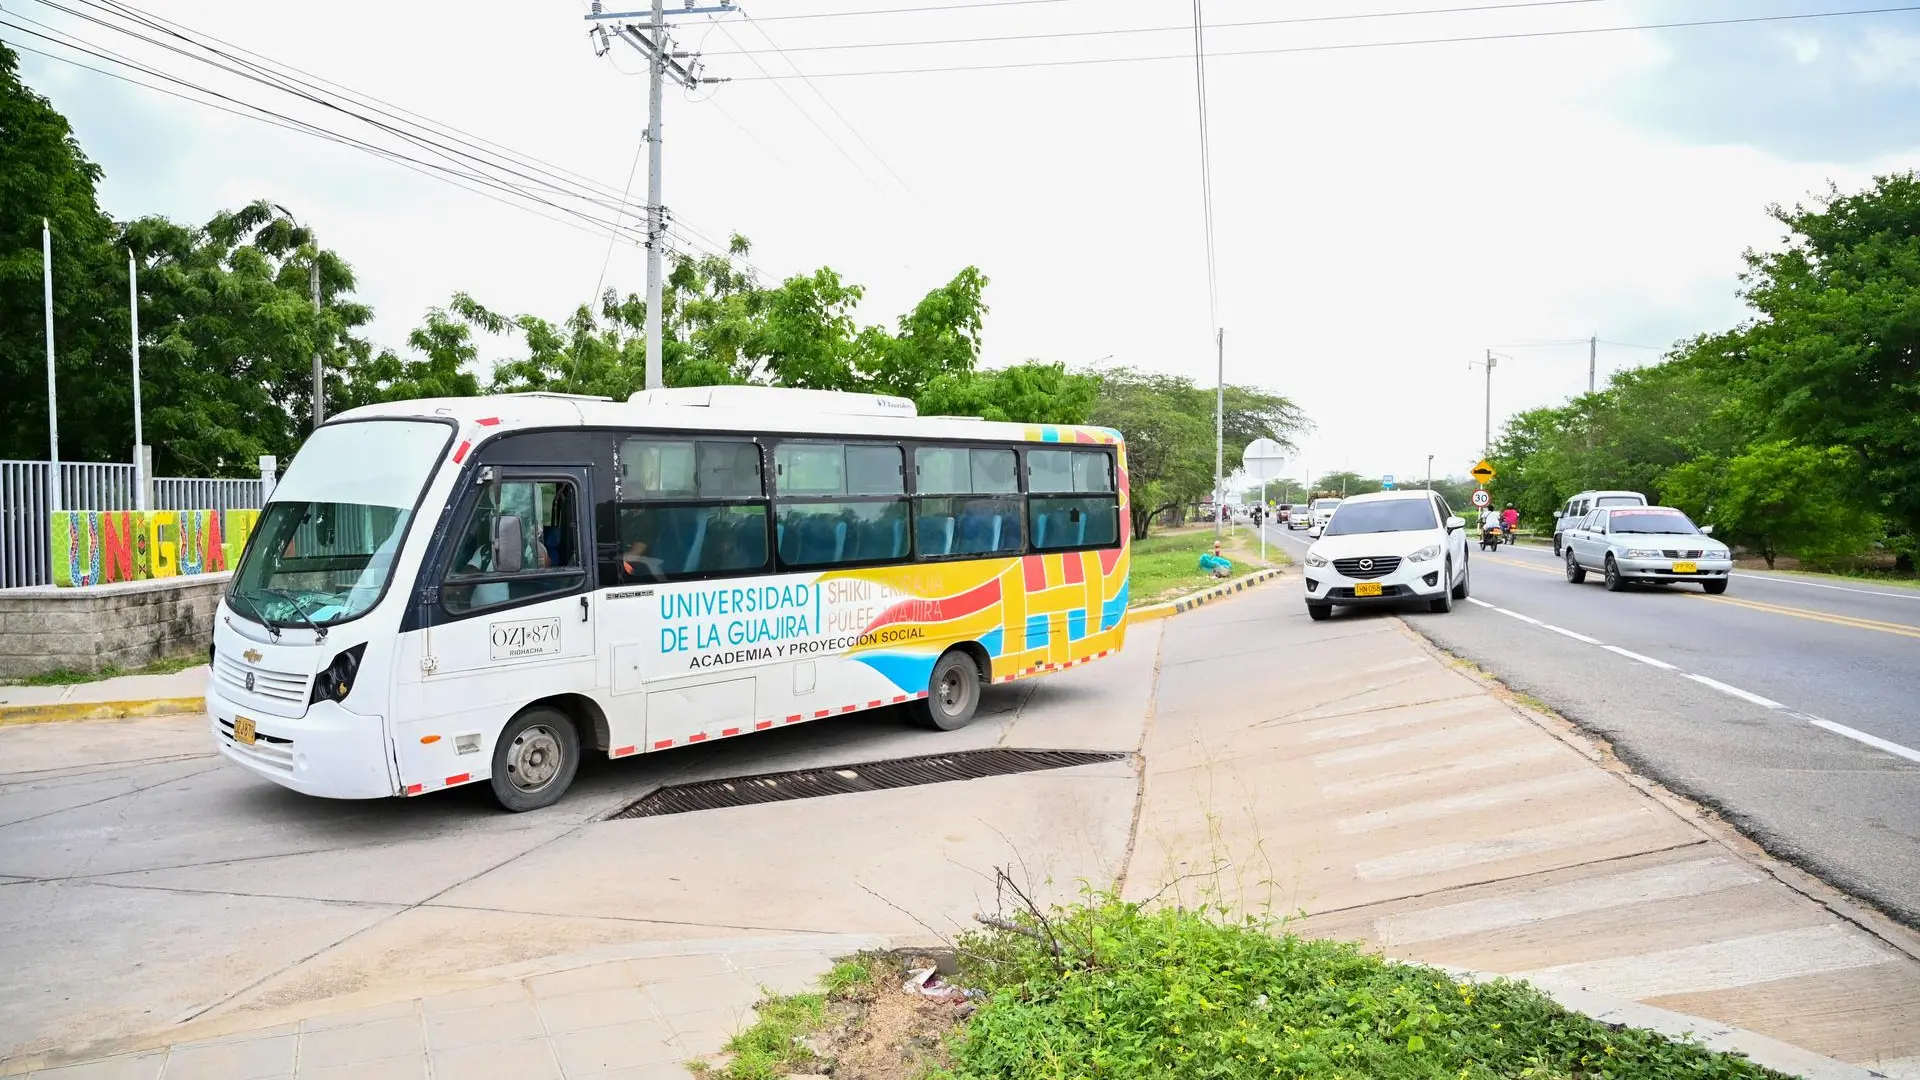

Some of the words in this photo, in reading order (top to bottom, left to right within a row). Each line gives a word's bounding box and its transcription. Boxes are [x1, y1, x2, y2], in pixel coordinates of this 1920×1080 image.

[1474, 494, 1488, 503] 30
[660, 583, 809, 620] UNIVERSIDAD
[509, 647, 544, 656] RIOHACHA
[661, 625, 689, 653] DE
[697, 622, 721, 649] LA
[728, 615, 809, 645] GUAJIRA
[689, 646, 772, 670] ACADEMIA
[776, 645, 787, 657] Y
[881, 628, 926, 647] SOCIAL
